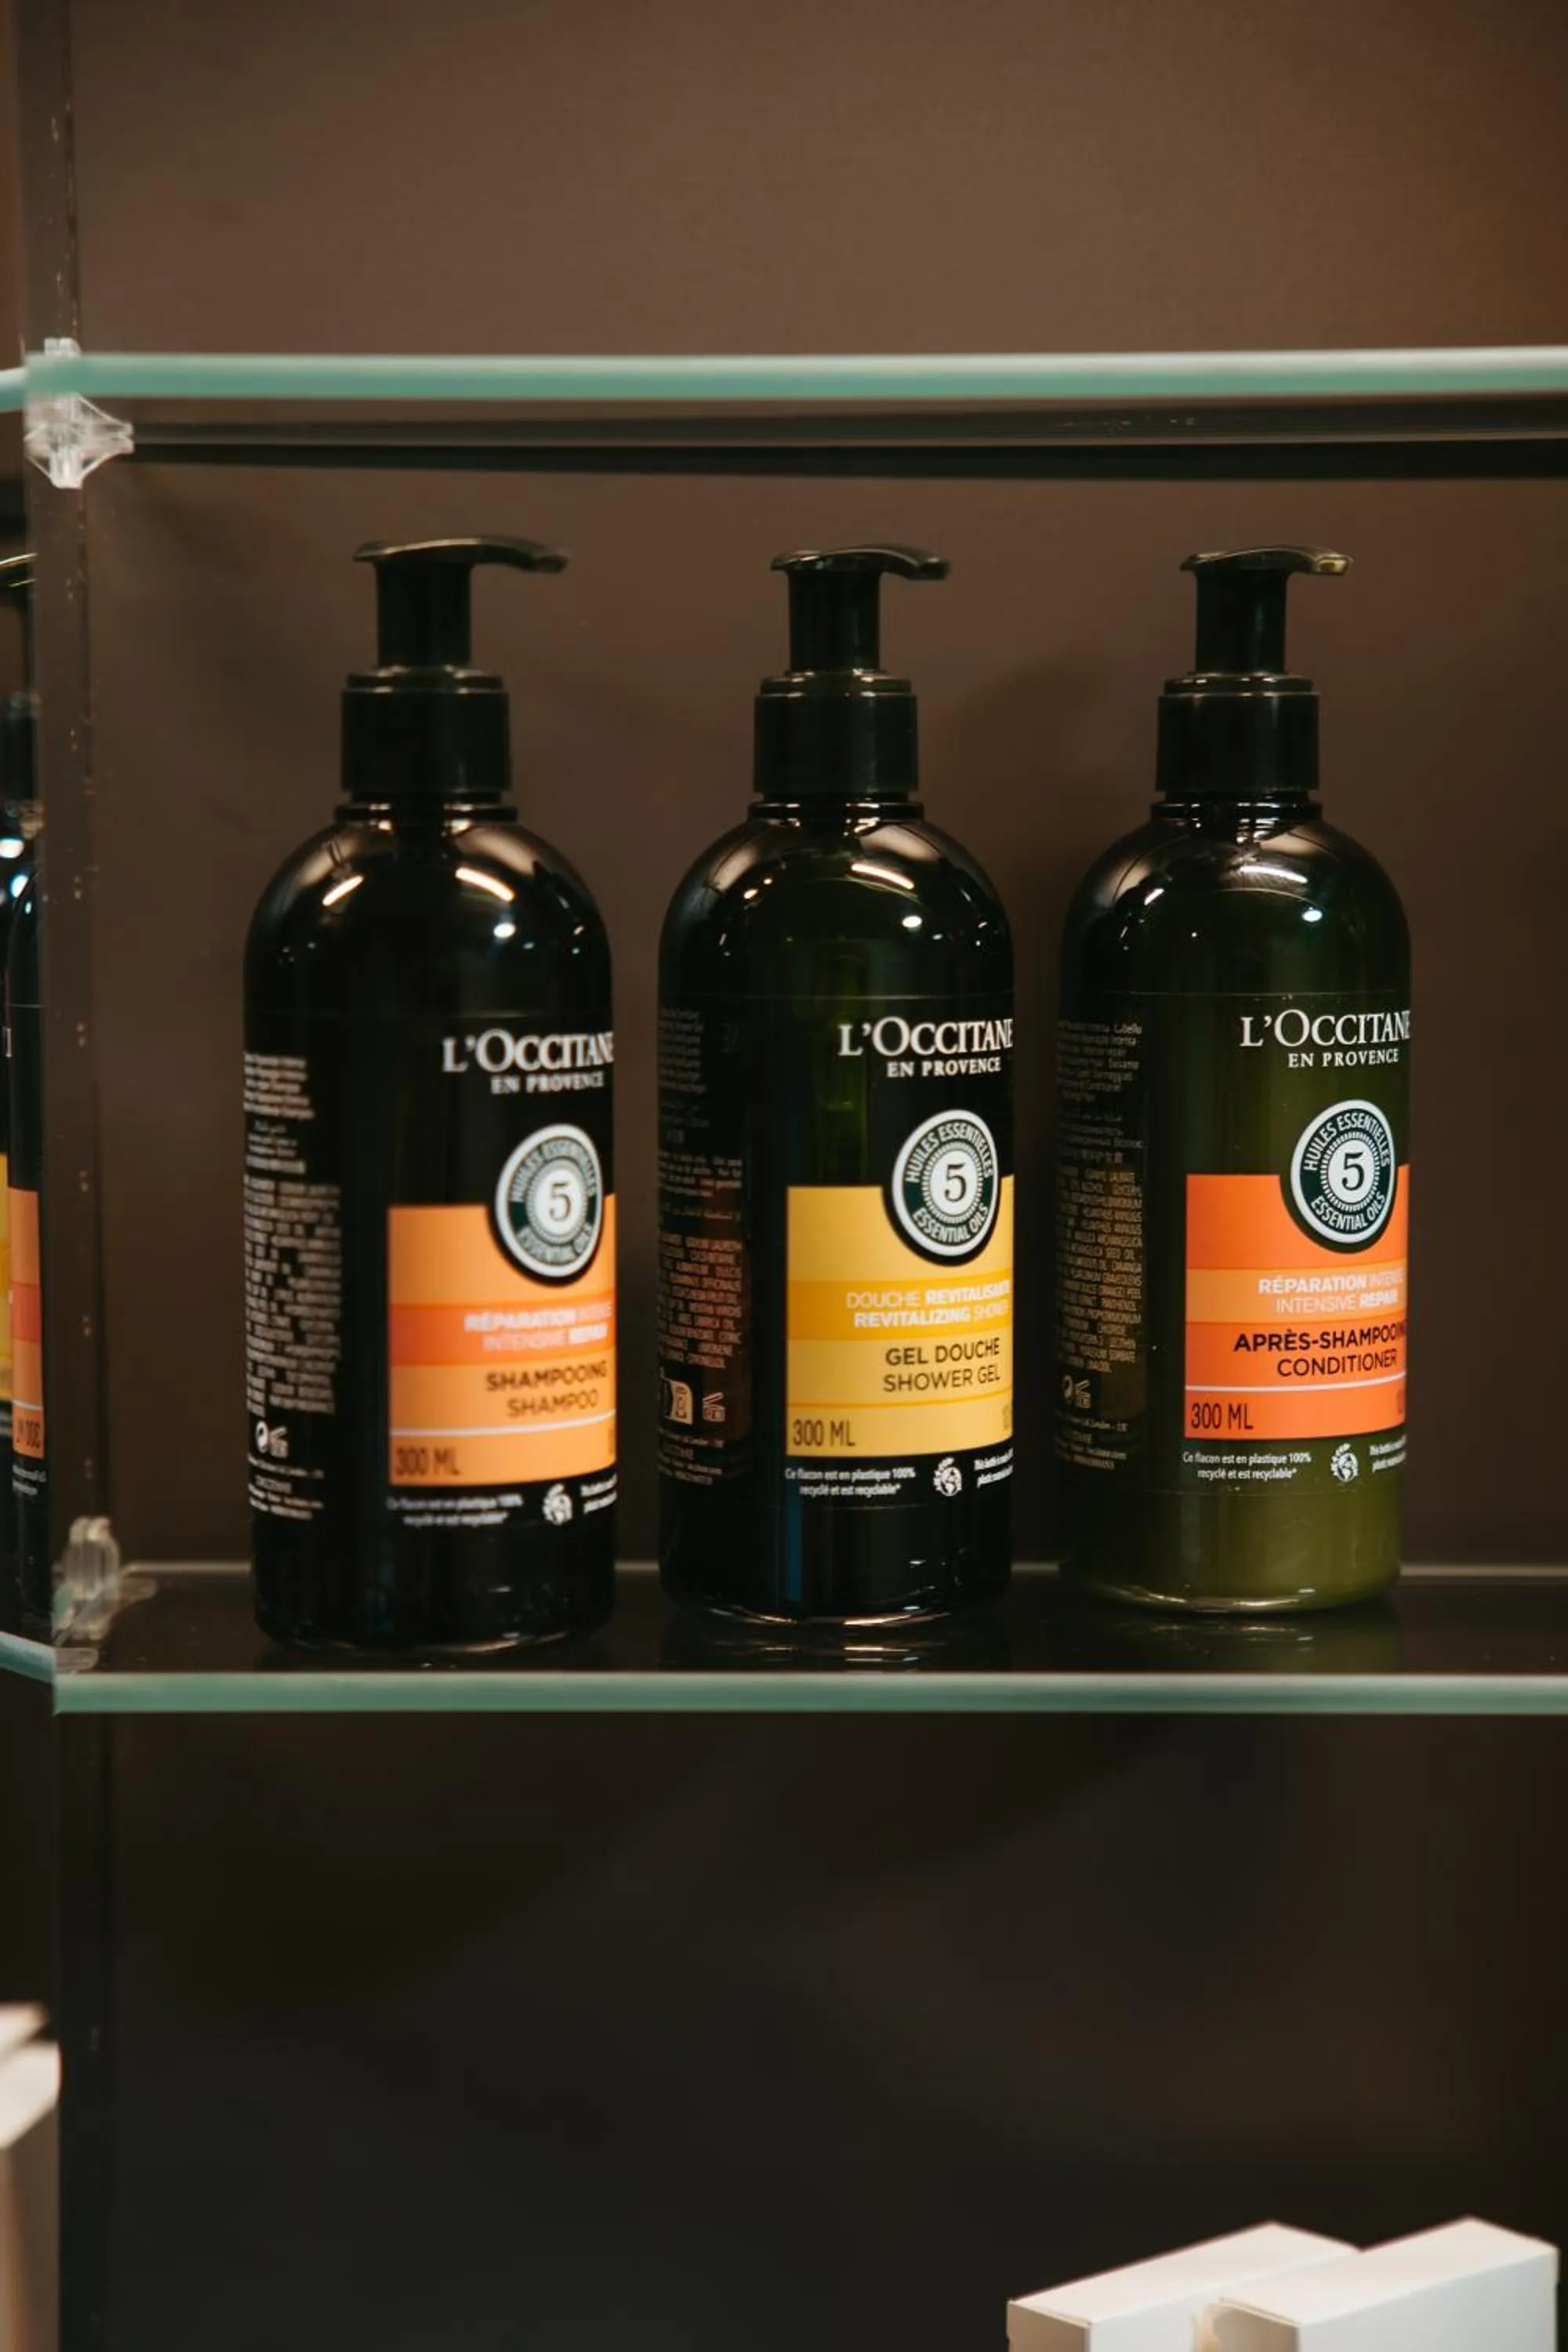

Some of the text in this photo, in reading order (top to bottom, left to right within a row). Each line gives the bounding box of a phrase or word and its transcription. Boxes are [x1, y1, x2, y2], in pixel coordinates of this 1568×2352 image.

[887, 1057, 1000, 1078] EN PROVENCE
[1288, 1048, 1399, 1068] EN PROVENCE
[491, 1071, 604, 1094] EN PROVENCE
[905, 1131, 941, 1183] HUILES
[937, 1122, 994, 1178] ESSENTIELLES
[1303, 1112, 1391, 1171] HUILES ESSENTIELLES
[944, 1163, 967, 1202] 5
[1341, 1151, 1364, 1191] 5
[549, 1181, 571, 1221] 5
[1311, 1191, 1385, 1230] ESSENTIAL OILS
[913, 1203, 989, 1243] ESSENTIAL OILS
[847, 1290, 920, 1309] DOUCHE
[1259, 1275, 1367, 1294] RÉPARATION
[854, 1305, 971, 1328] REVITALIZING
[1276, 1295, 1356, 1314] INTENSIVE
[1233, 1321, 1406, 1352] APRÈS-SHAMPOO
[885, 1337, 1000, 1367] GEL DOUCHE
[1277, 1348, 1397, 1377] CONDITIONER
[485, 1360, 607, 1392] SHAMPOOING
[883, 1364, 1000, 1393] SHOWER GEL
[506, 1388, 598, 1418] SHAMPOO
[1191, 1403, 1254, 1429] 300 ML
[793, 1419, 855, 1446] 300 ML
[395, 1446, 428, 1477] 300
